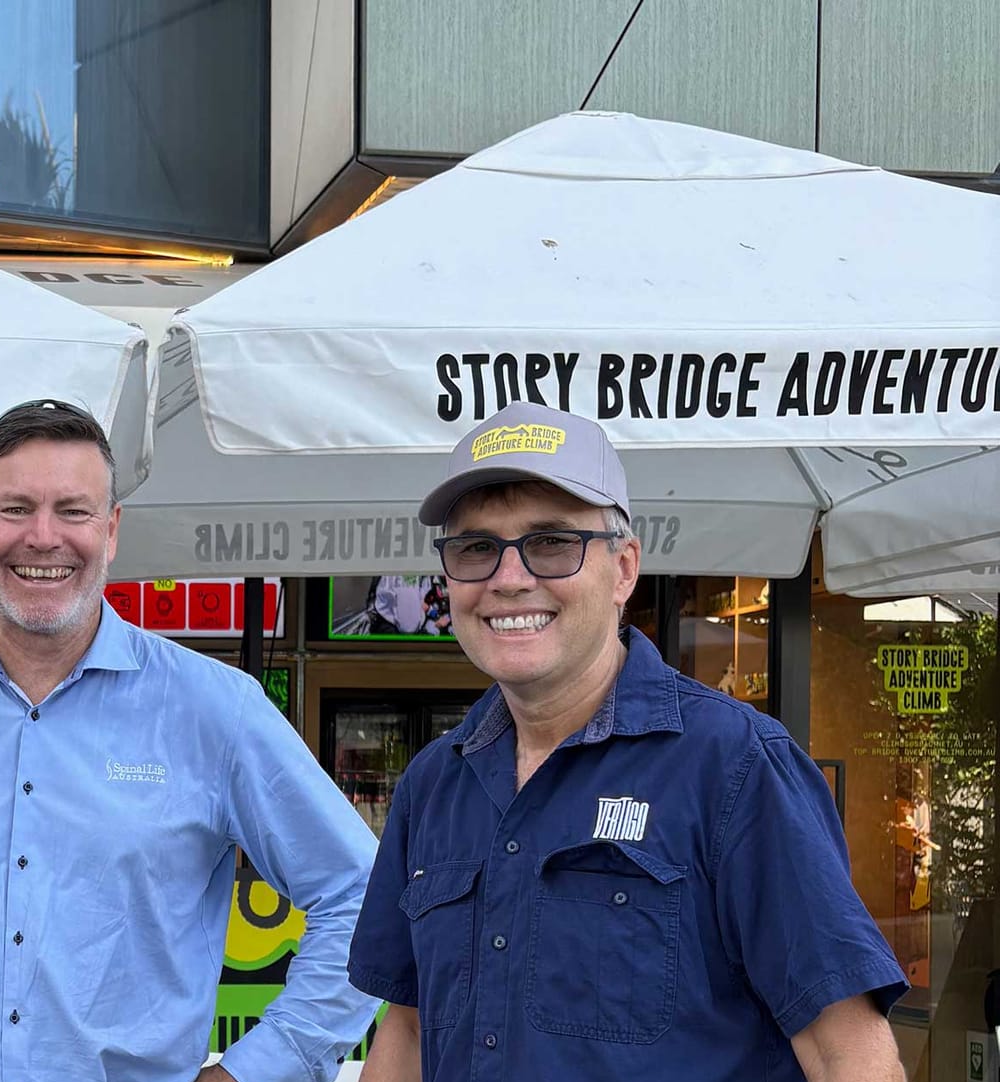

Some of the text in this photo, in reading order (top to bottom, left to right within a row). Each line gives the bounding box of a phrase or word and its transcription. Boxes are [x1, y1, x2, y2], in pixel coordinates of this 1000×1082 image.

[18, 271, 204, 288] DGE
[436, 347, 1000, 422] STORY BRIDGE ADVENTU
[531, 427, 561, 441] BRIDGE
[477, 438, 553, 458] ADVENTURE CLIMB
[157, 579, 173, 588] NO
[882, 648, 964, 667] STORY BRIDGE
[889, 670, 957, 688] ADVENTURE
[903, 691, 942, 709] CLIMB
[113, 762, 166, 775] Spinal Life
[112, 773, 166, 783] AUSTRALIA
[592, 797, 649, 841] VERTIGO
